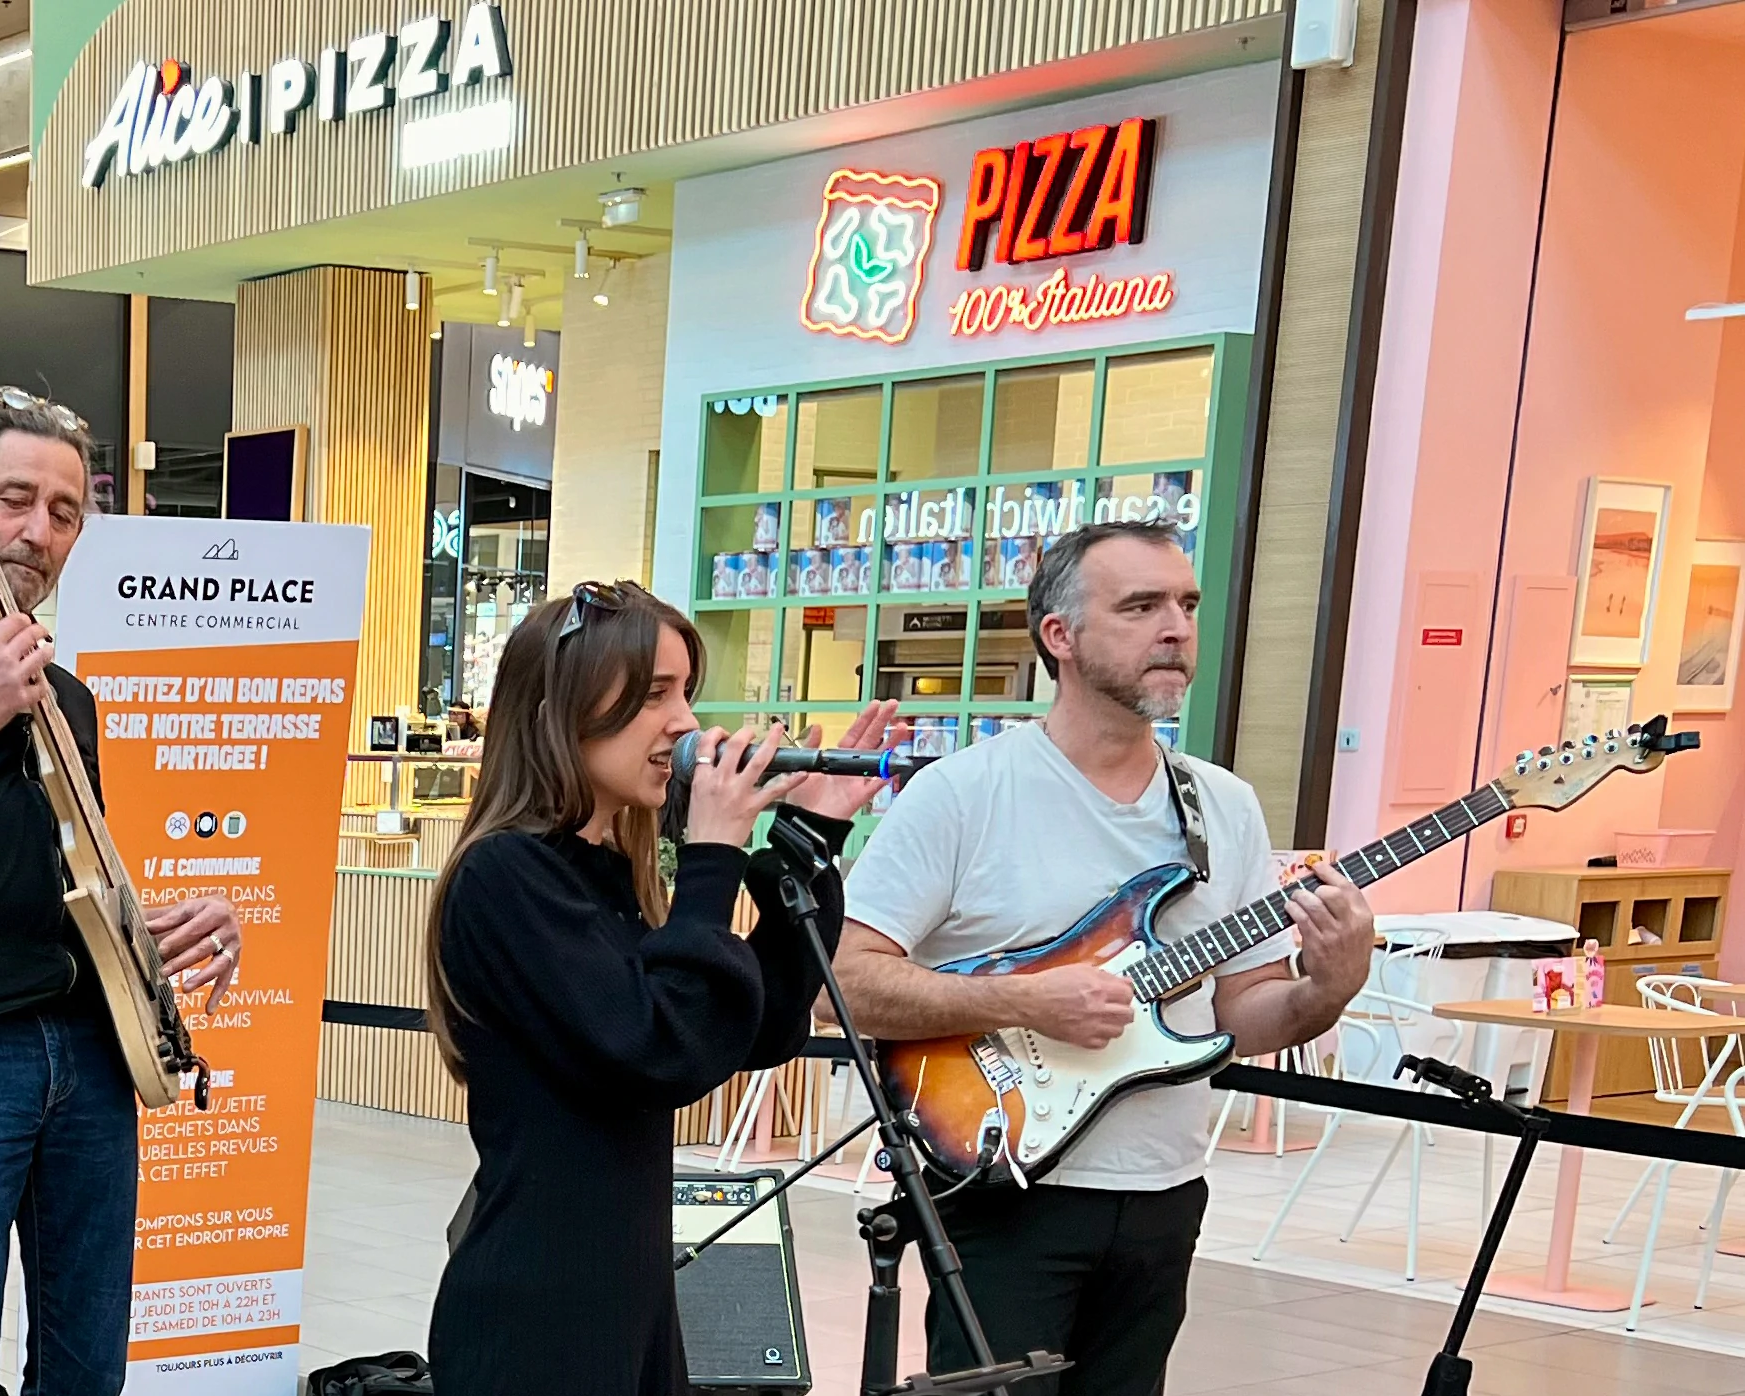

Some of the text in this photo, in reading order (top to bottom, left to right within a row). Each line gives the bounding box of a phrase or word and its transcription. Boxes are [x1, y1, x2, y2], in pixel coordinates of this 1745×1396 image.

[82, 56, 239, 190] Alice
[269, 2, 513, 136] PIZZA
[957, 118, 1155, 272] PIZZA
[118, 575, 315, 603] GRAND PLACE
[125, 613, 300, 630] CENTRE COMMERCIAL
[86, 676, 346, 704] PROFITEZ D'UN BON REPAS
[105, 713, 322, 740] SUR NOTRE TERRASSE
[154, 745, 256, 771] PARTAGEE
[159, 858, 176, 878] JE
[177, 857, 262, 877] COMMANDE
[231, 884, 276, 904] DANS
[174, 988, 294, 1009] ENT ONVIVIAL
[211, 1012, 252, 1029] AMIS
[143, 1116, 260, 1140] DECHETS DANS
[140, 1136, 278, 1162] UBELLES PREVUES
[150, 1164, 181, 1182] CET
[183, 1160, 229, 1180] EFFET
[134, 1206, 274, 1232] OMPTONS SUR VOUS
[146, 1233, 173, 1249] CET
[175, 1228, 235, 1248] ENDROIT
[237, 1223, 290, 1241] PROPRE
[131, 1277, 273, 1303] RANTS SONT OUVERTS
[141, 1304, 176, 1319] JEUDI
[179, 1300, 195, 1314] DE
[198, 1298, 219, 1313] 10H
[235, 1295, 259, 1309] 22H
[262, 1293, 277, 1306] ET
[134, 1321, 149, 1336] ET
[152, 1316, 198, 1334] SAMEDI
[202, 1313, 218, 1329] DE
[221, 1311, 242, 1326] 10H
[257, 1308, 281, 1322] 23H
[156, 1358, 202, 1374] TOUJOURS
[203, 1356, 225, 1369] PLUS
